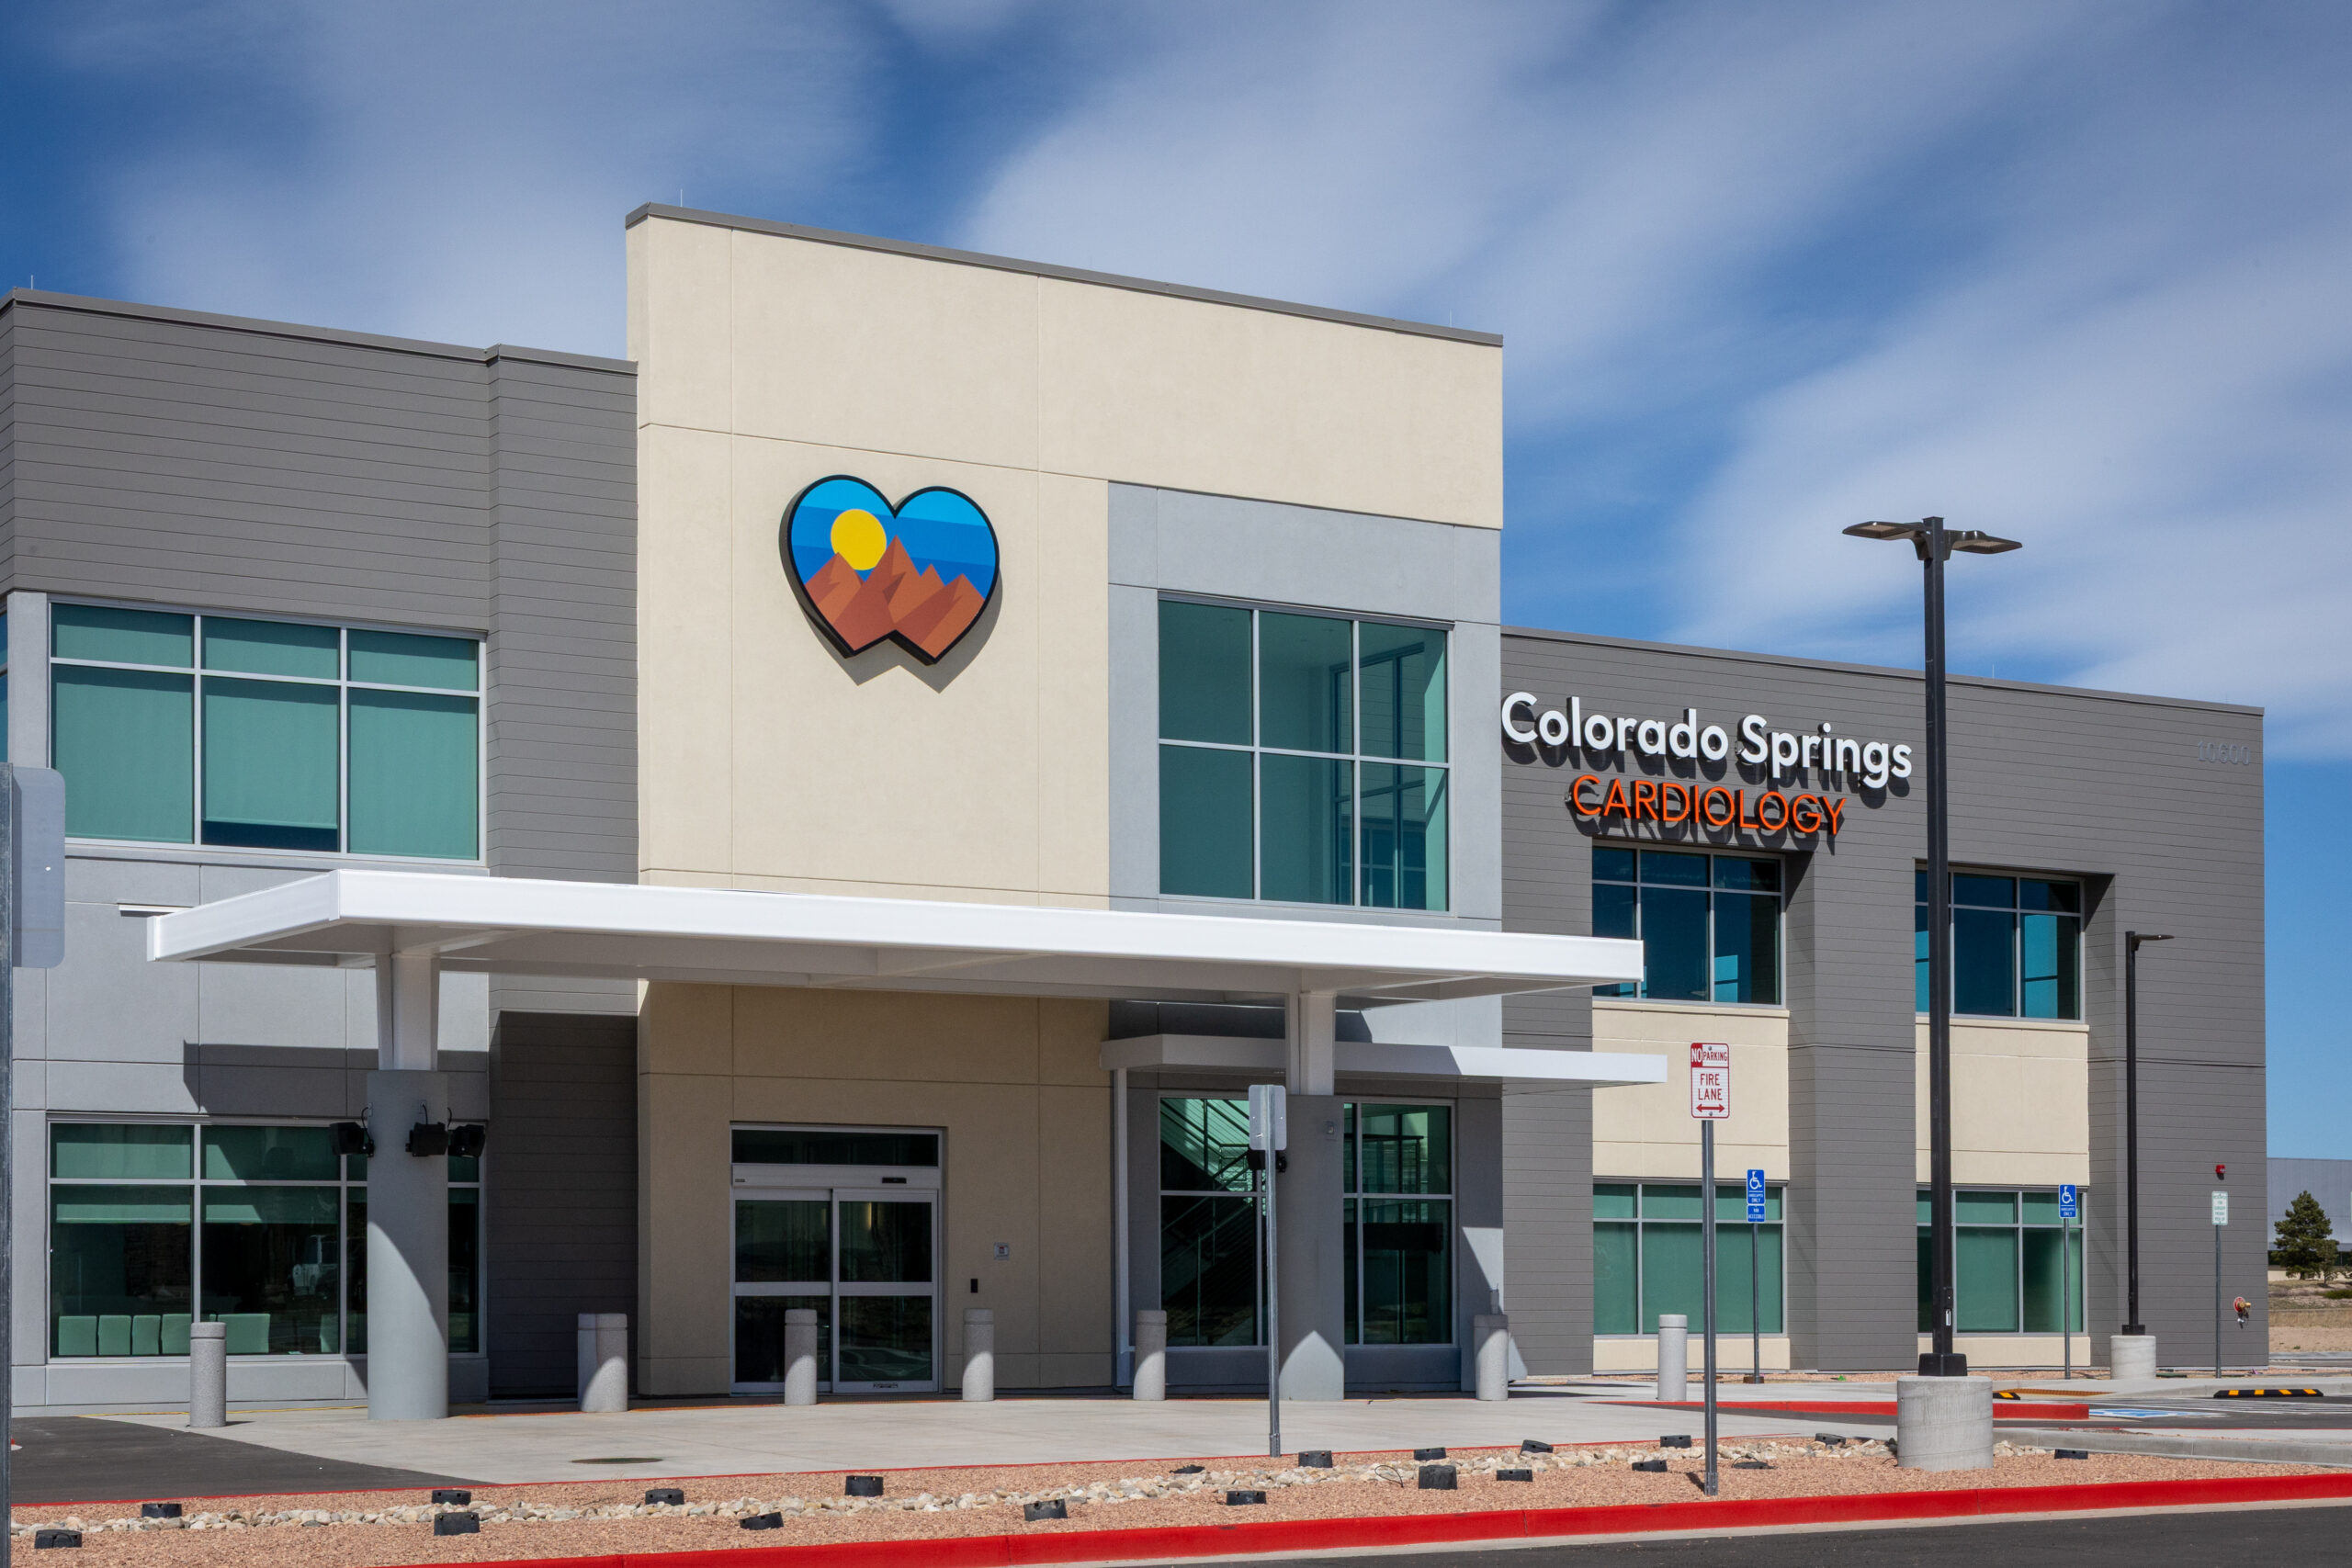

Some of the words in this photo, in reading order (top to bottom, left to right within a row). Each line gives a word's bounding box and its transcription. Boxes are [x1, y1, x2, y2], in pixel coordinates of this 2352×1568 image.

[1501, 692, 1729, 761] Colorado
[1739, 715, 1913, 789] Springs
[1571, 774, 1848, 836] CARDIOLOGY
[1691, 1048, 1702, 1063] NO
[1702, 1051, 1727, 1062] PARKING
[1700, 1073, 1720, 1086] FIRE
[1698, 1089, 1723, 1100] LANE
